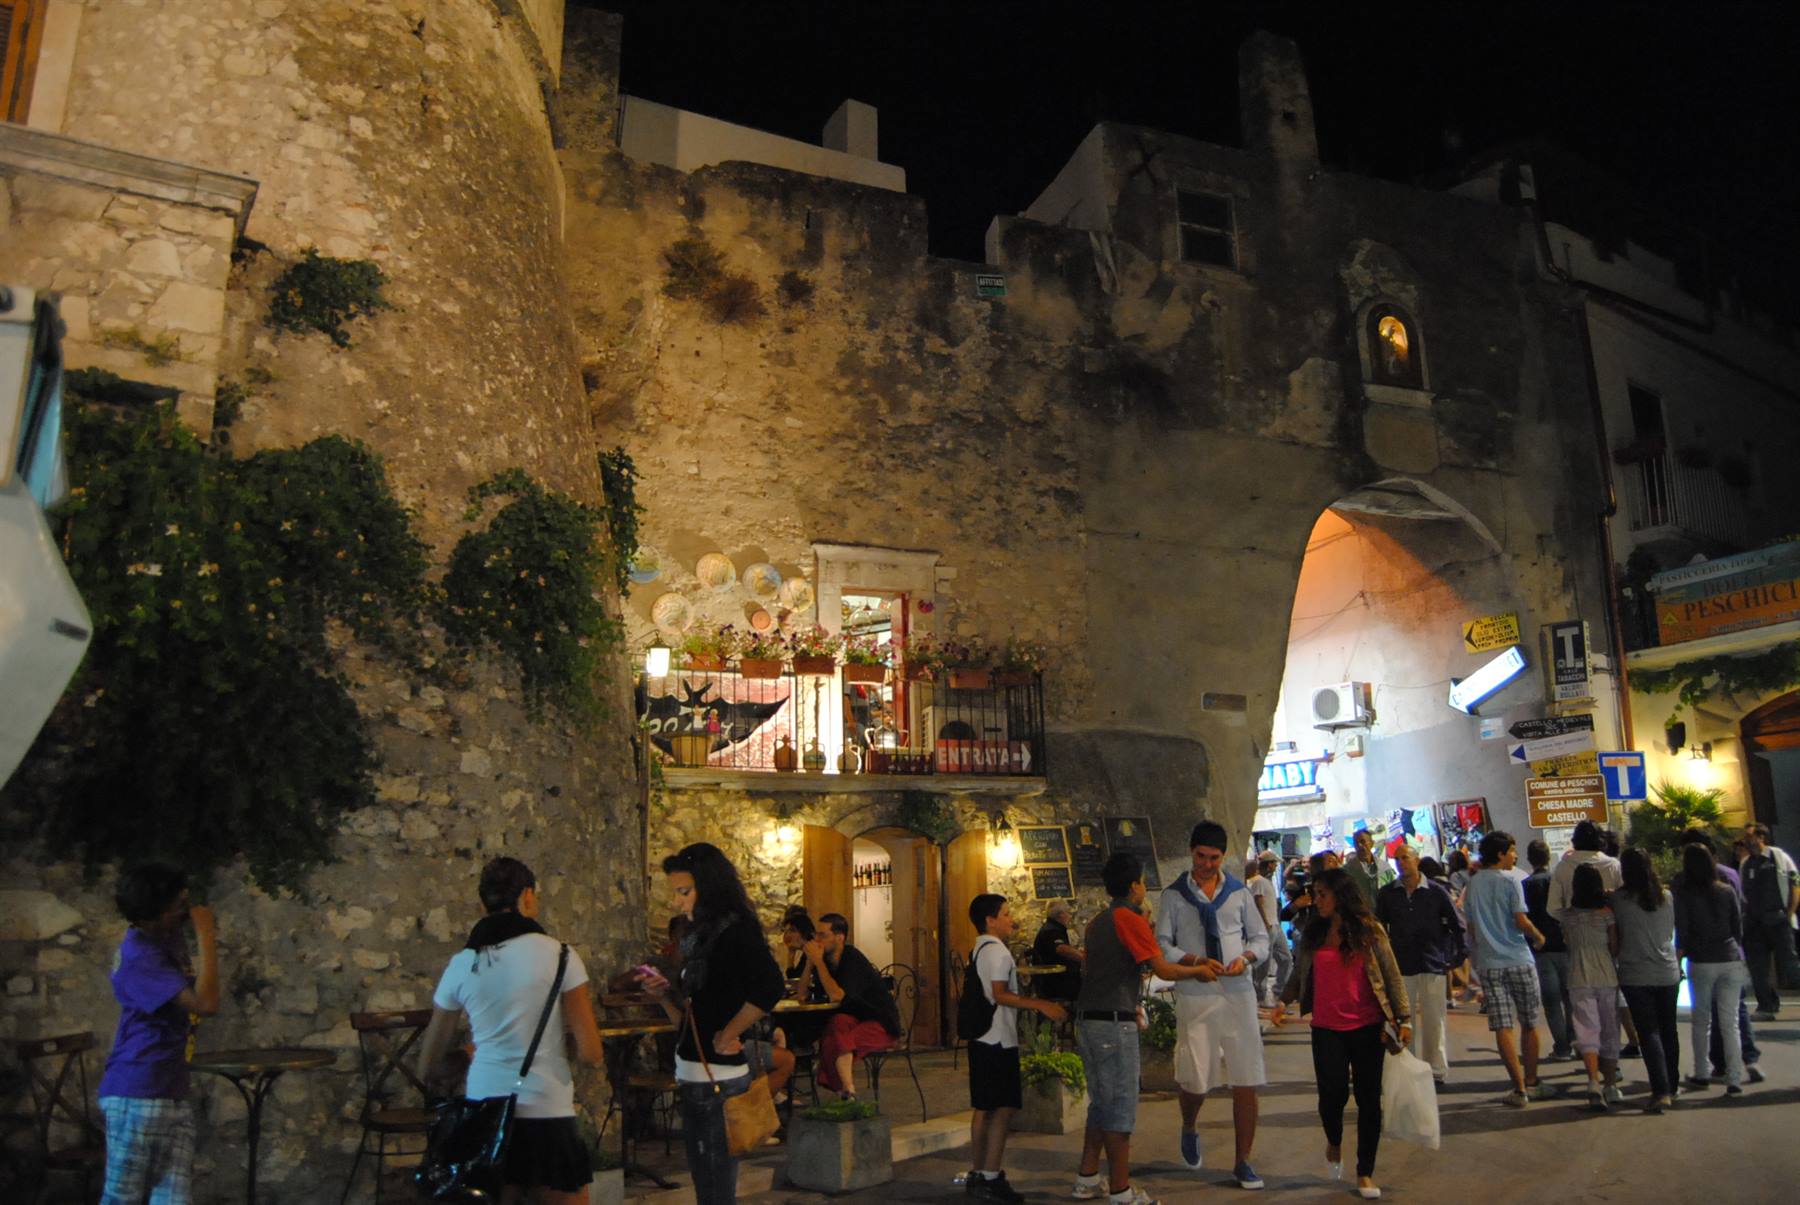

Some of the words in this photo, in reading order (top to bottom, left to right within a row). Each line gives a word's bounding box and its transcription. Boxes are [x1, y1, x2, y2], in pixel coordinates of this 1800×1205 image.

[1684, 580, 1798, 621] PESCHICI
[1520, 719, 1553, 728] CASTELLO
[937, 746, 1009, 766] ENTRATA
[1530, 781, 1559, 789] COMUNE
[1567, 778, 1599, 787] PESCHICI
[1538, 801, 1565, 810] CHIESA
[1566, 799, 1594, 808] MADRE
[1547, 812, 1587, 822] CASTELLO
